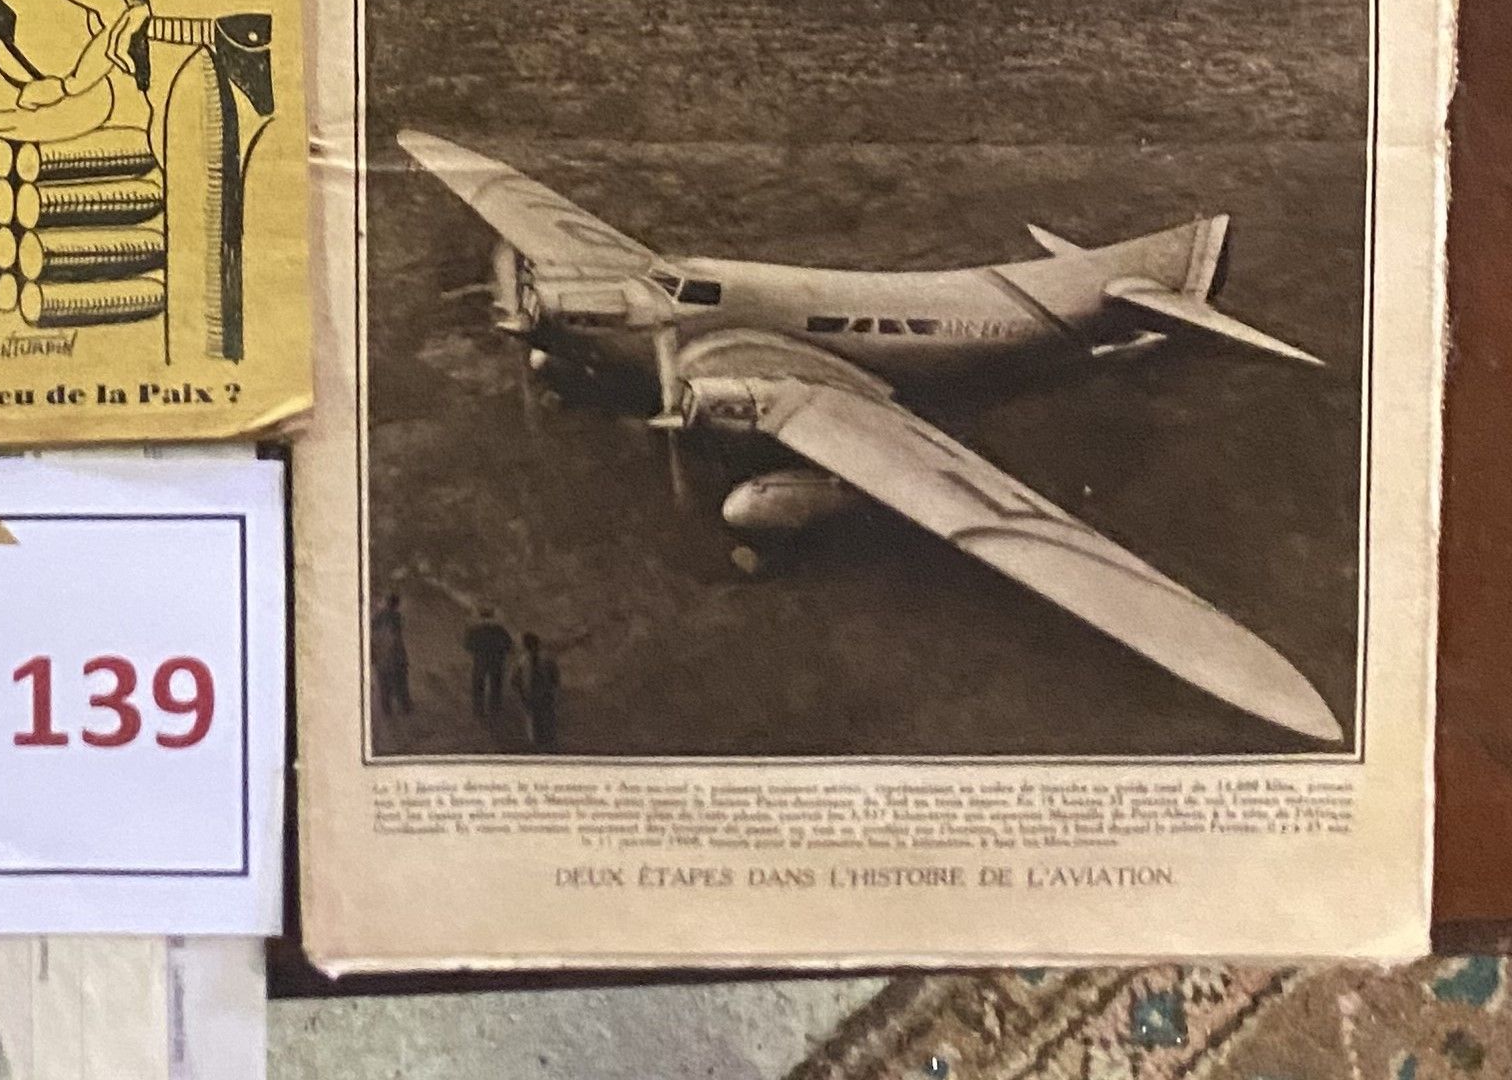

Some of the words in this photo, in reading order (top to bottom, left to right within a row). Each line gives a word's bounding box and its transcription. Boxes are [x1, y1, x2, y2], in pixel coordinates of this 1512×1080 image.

[46, 383, 86, 406] de
[96, 383, 127, 405] la
[138, 381, 215, 405] Paix
[225, 383, 242, 404] ?
[12, 654, 216, 749] 139
[554, 867, 624, 887] DEUX
[637, 863, 734, 887] ÉTAPES
[748, 866, 816, 887] DANS
[830, 865, 965, 887] L'HISTOIRE
[978, 866, 1013, 887] DE
